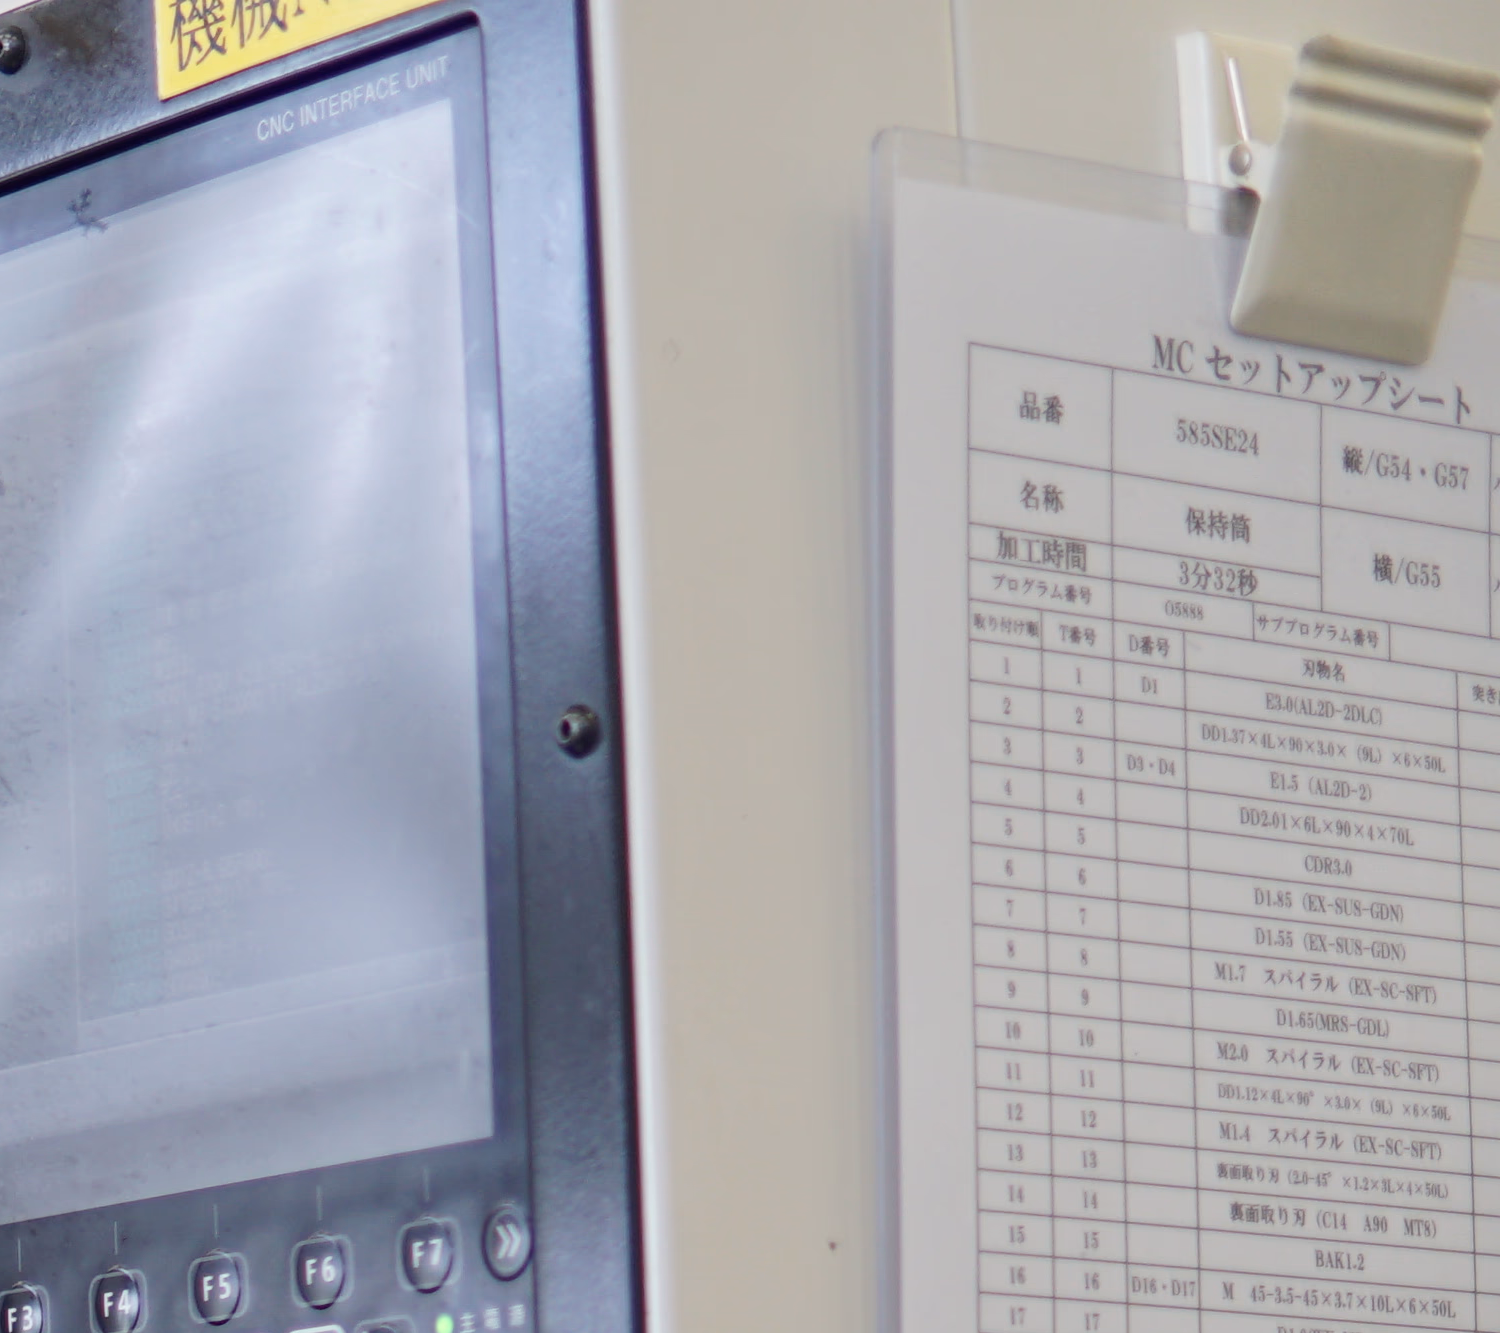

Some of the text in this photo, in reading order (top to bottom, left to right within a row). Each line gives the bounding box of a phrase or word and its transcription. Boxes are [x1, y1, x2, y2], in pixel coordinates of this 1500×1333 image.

[257, 54, 449, 142] CNC INTERFACE UNIT
[1151, 334, 1470, 424] MC セットアップシート
[1019, 390, 1064, 425] 品番
[1176, 419, 1259, 456] 585SE24
[1020, 480, 1065, 513] 名称
[1185, 507, 1252, 543] 保持筒
[997, 531, 1086, 572] 加工時間
[1179, 562, 1257, 595] 3分32秒
[1373, 553, 1440, 588] 横/G55
[992, 573, 1091, 605] プログラム番号
[1129, 635, 1170, 657] D番号
[1255, 615, 1378, 648] サブプログラム番号
[1301, 659, 1345, 683] 刃物名
[1305, 856, 1352, 877] CDR3.0
[1255, 928, 1293, 948] D1.55
[411, 1239, 442, 1268] F7
[1315, 1251, 1365, 1271] BAK1.2
[203, 1272, 230, 1301] F5
[305, 1256, 334, 1286] F6
[7, 1305, 34, 1332] F3
[103, 1289, 131, 1318] F4
